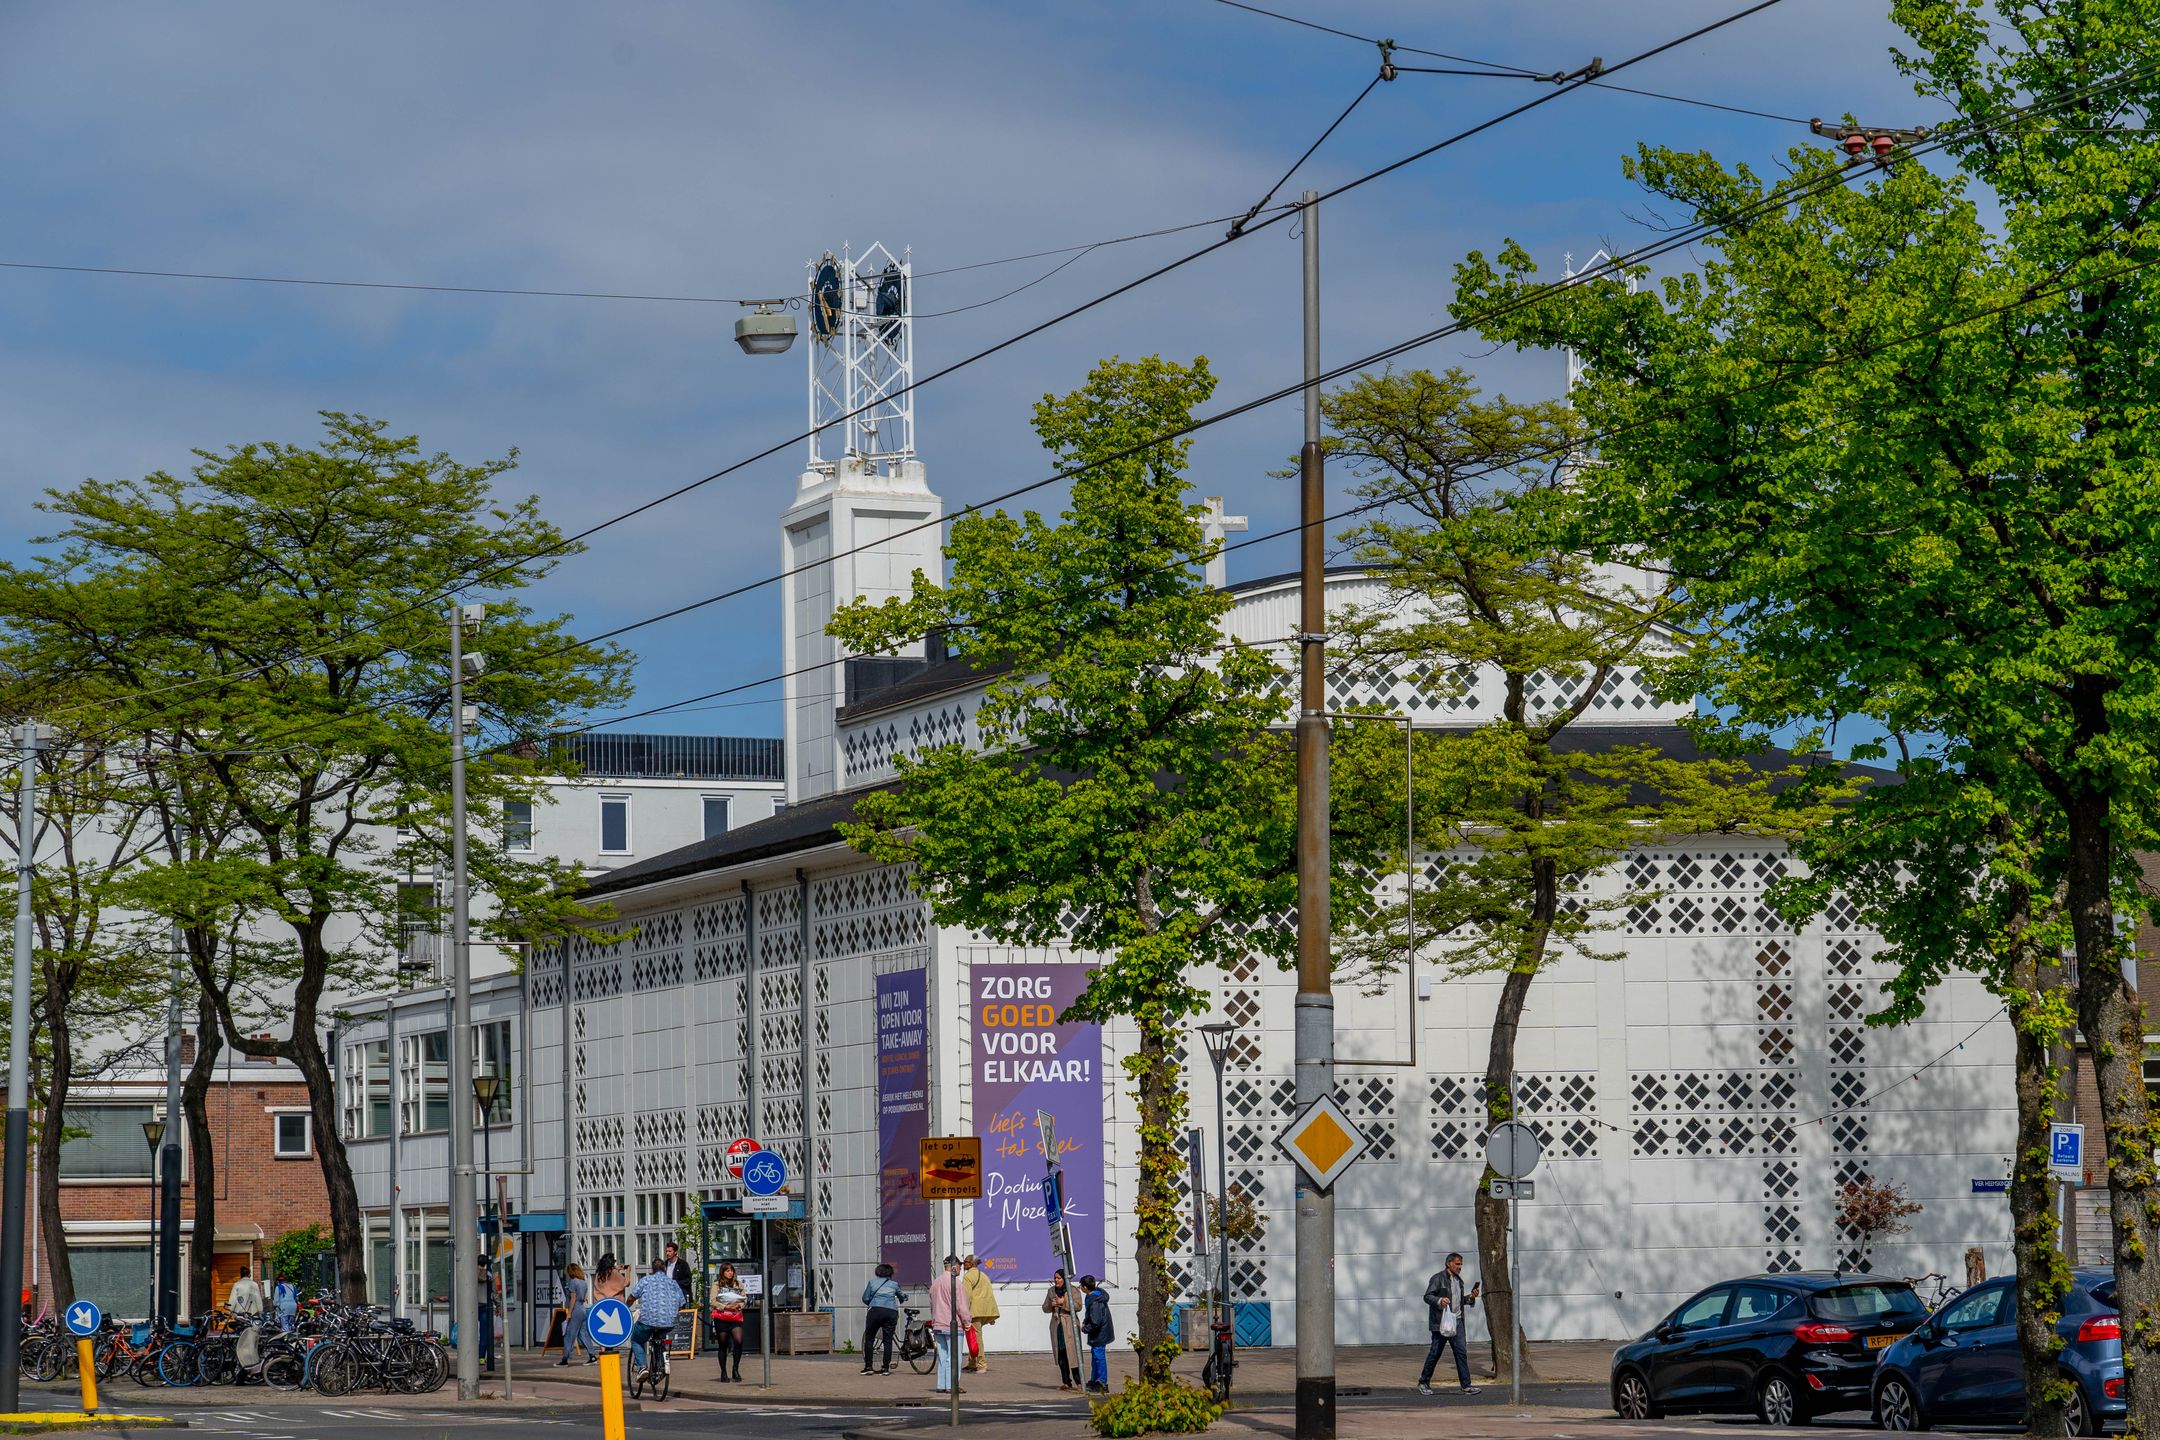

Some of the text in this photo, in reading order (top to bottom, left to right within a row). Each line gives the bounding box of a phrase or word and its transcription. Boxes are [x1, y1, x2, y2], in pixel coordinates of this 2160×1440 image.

[981, 977, 1052, 999] ZORG
[880, 990, 909, 1011] WIJ ZIJN
[881, 1009, 923, 1029] OPEN VOOR
[982, 1004, 1055, 1027] GOED
[881, 1030, 923, 1050] TAKE-AWAY
[981, 1032, 1057, 1055] VOOR
[984, 1059, 1090, 1083] ELKAAR!
[894, 1092, 903, 1101] HET
[903, 1091, 912, 1100] HELE
[912, 1090, 924, 1099] MENU
[882, 1106, 888, 1114] OP
[925, 1142, 938, 1150] let
[942, 1143, 954, 1152] op
[1036, 1136, 1083, 1156] sel
[2058, 1134, 2069, 1150] P
[930, 1186, 977, 1195] drempels
[987, 1172, 1043, 1208] Podiu
[1044, 1181, 1052, 1206] P
